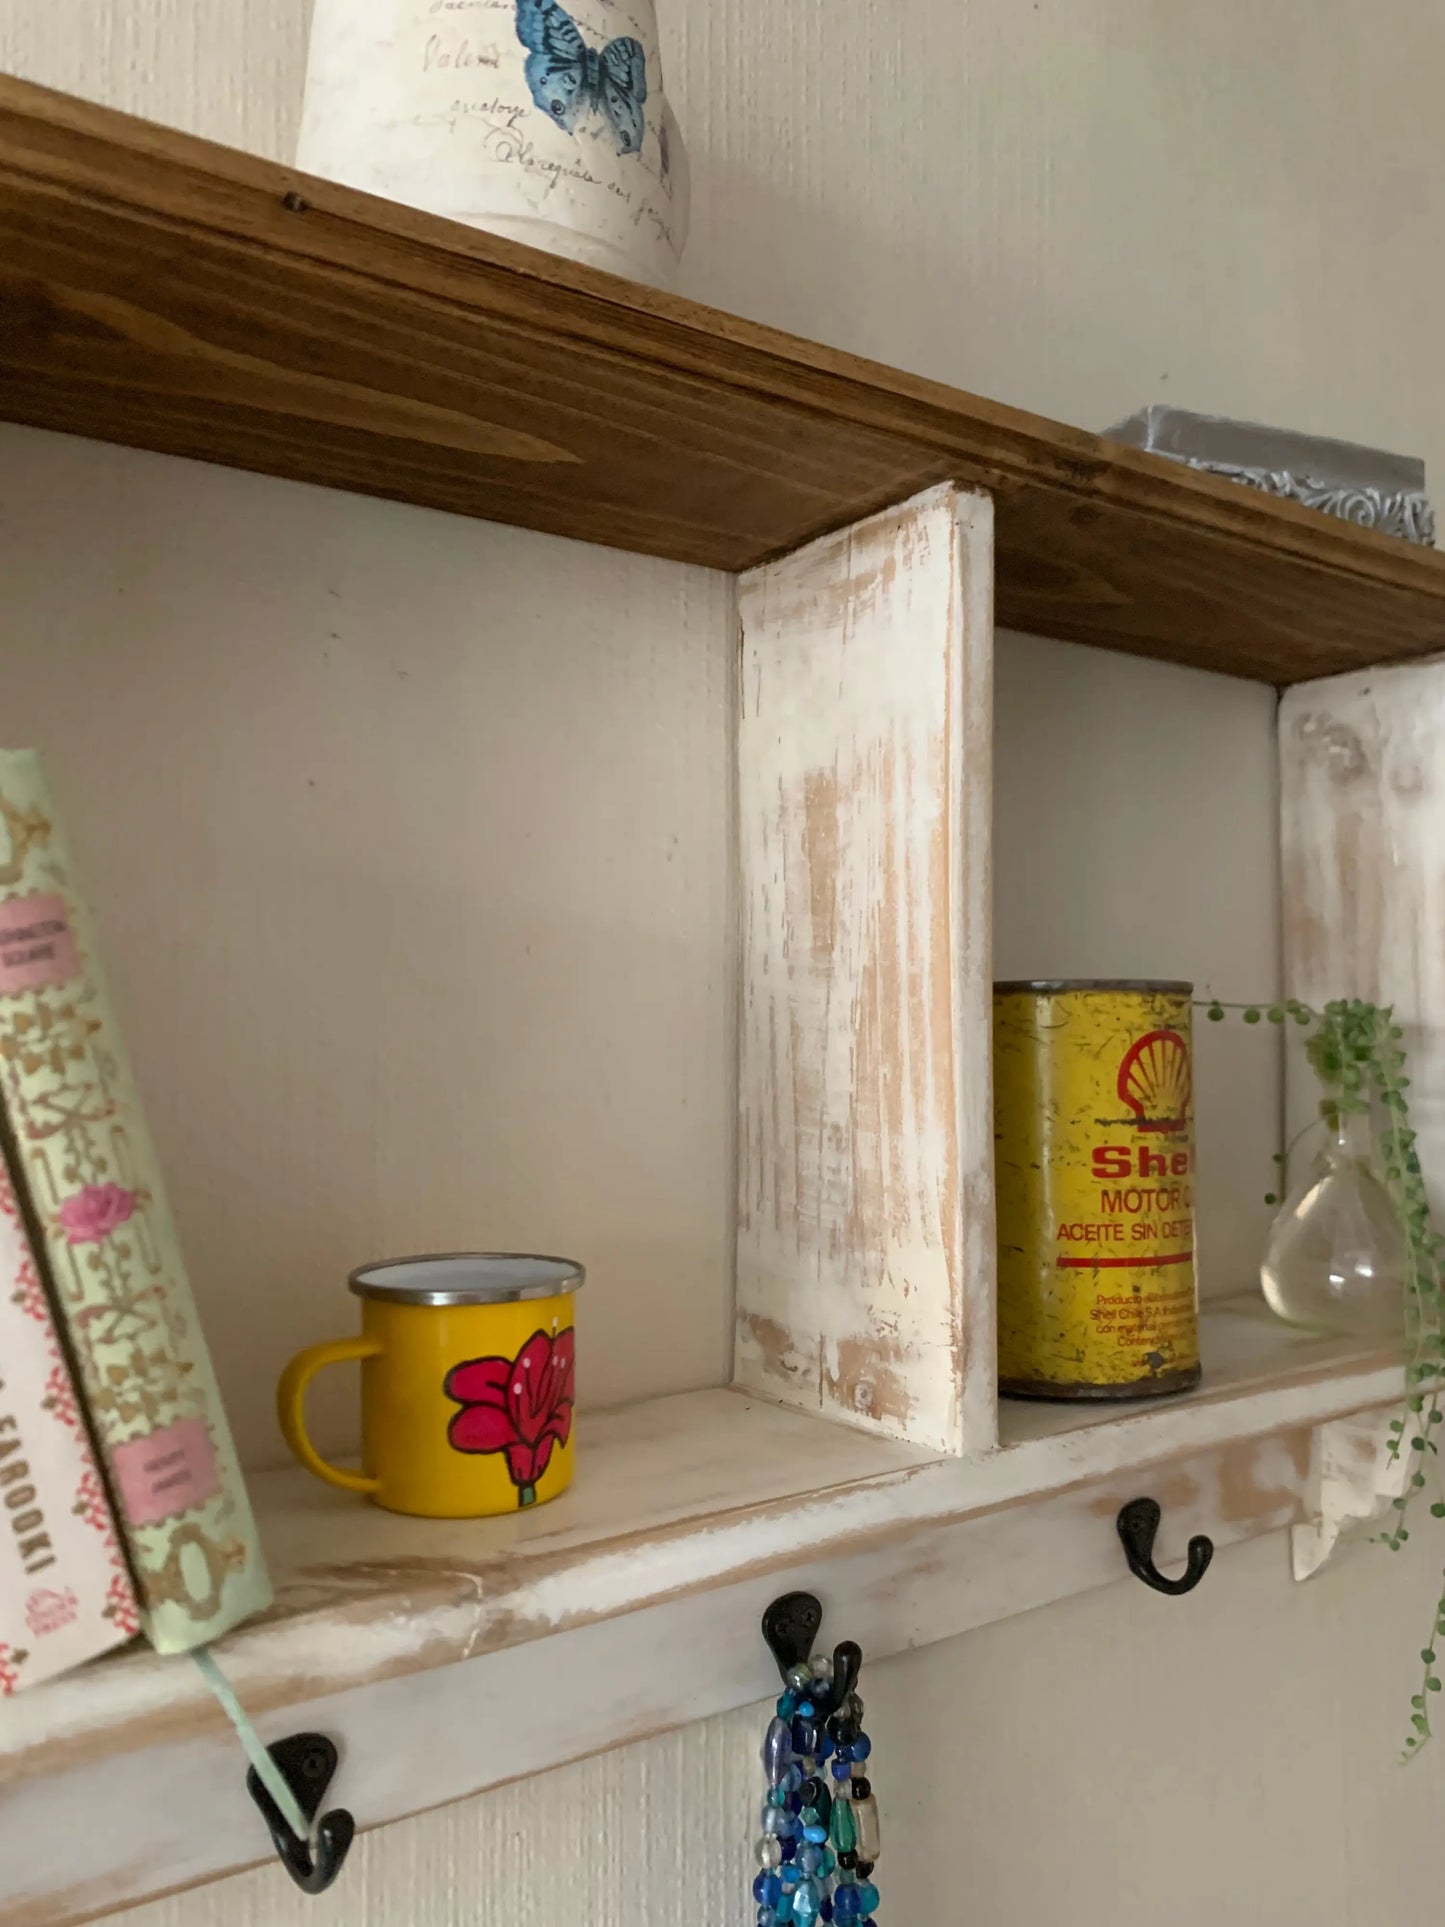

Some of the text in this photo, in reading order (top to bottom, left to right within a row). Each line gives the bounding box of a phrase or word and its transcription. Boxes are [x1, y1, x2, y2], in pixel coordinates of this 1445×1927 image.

[1101, 1187, 1181, 1214] MOTOR
[1056, 1223, 1125, 1242] ACEITE
[1131, 1222, 1158, 1242] SIN
